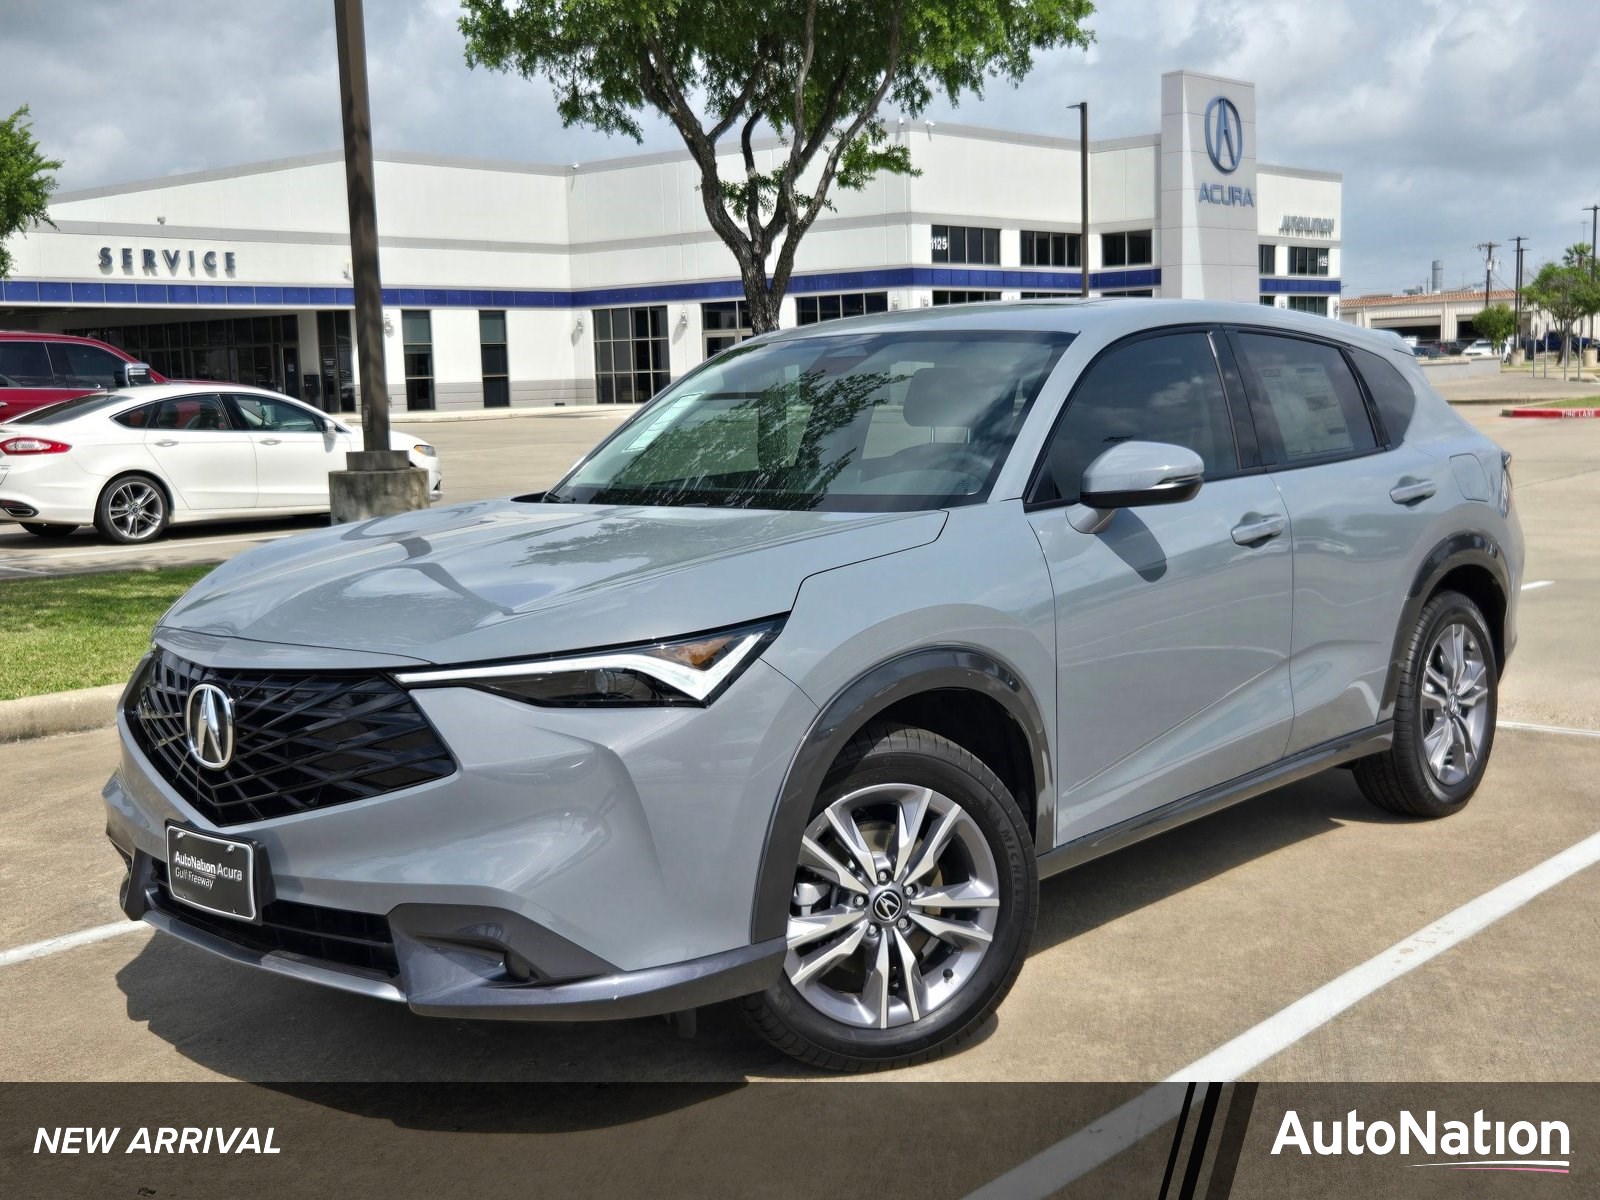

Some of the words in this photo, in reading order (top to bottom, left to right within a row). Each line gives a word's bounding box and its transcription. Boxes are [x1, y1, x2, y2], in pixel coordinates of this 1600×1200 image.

[1199, 182, 1255, 208] ACURA
[930, 236, 948, 250] 1125
[98, 246, 236, 273] SERVICE
[1578, 409, 1595, 418] LANE
[174, 850, 217, 875] AutoNation
[216, 862, 243, 881] Acura
[175, 866, 188, 880] Gulf
[188, 870, 214, 890] Freeway
